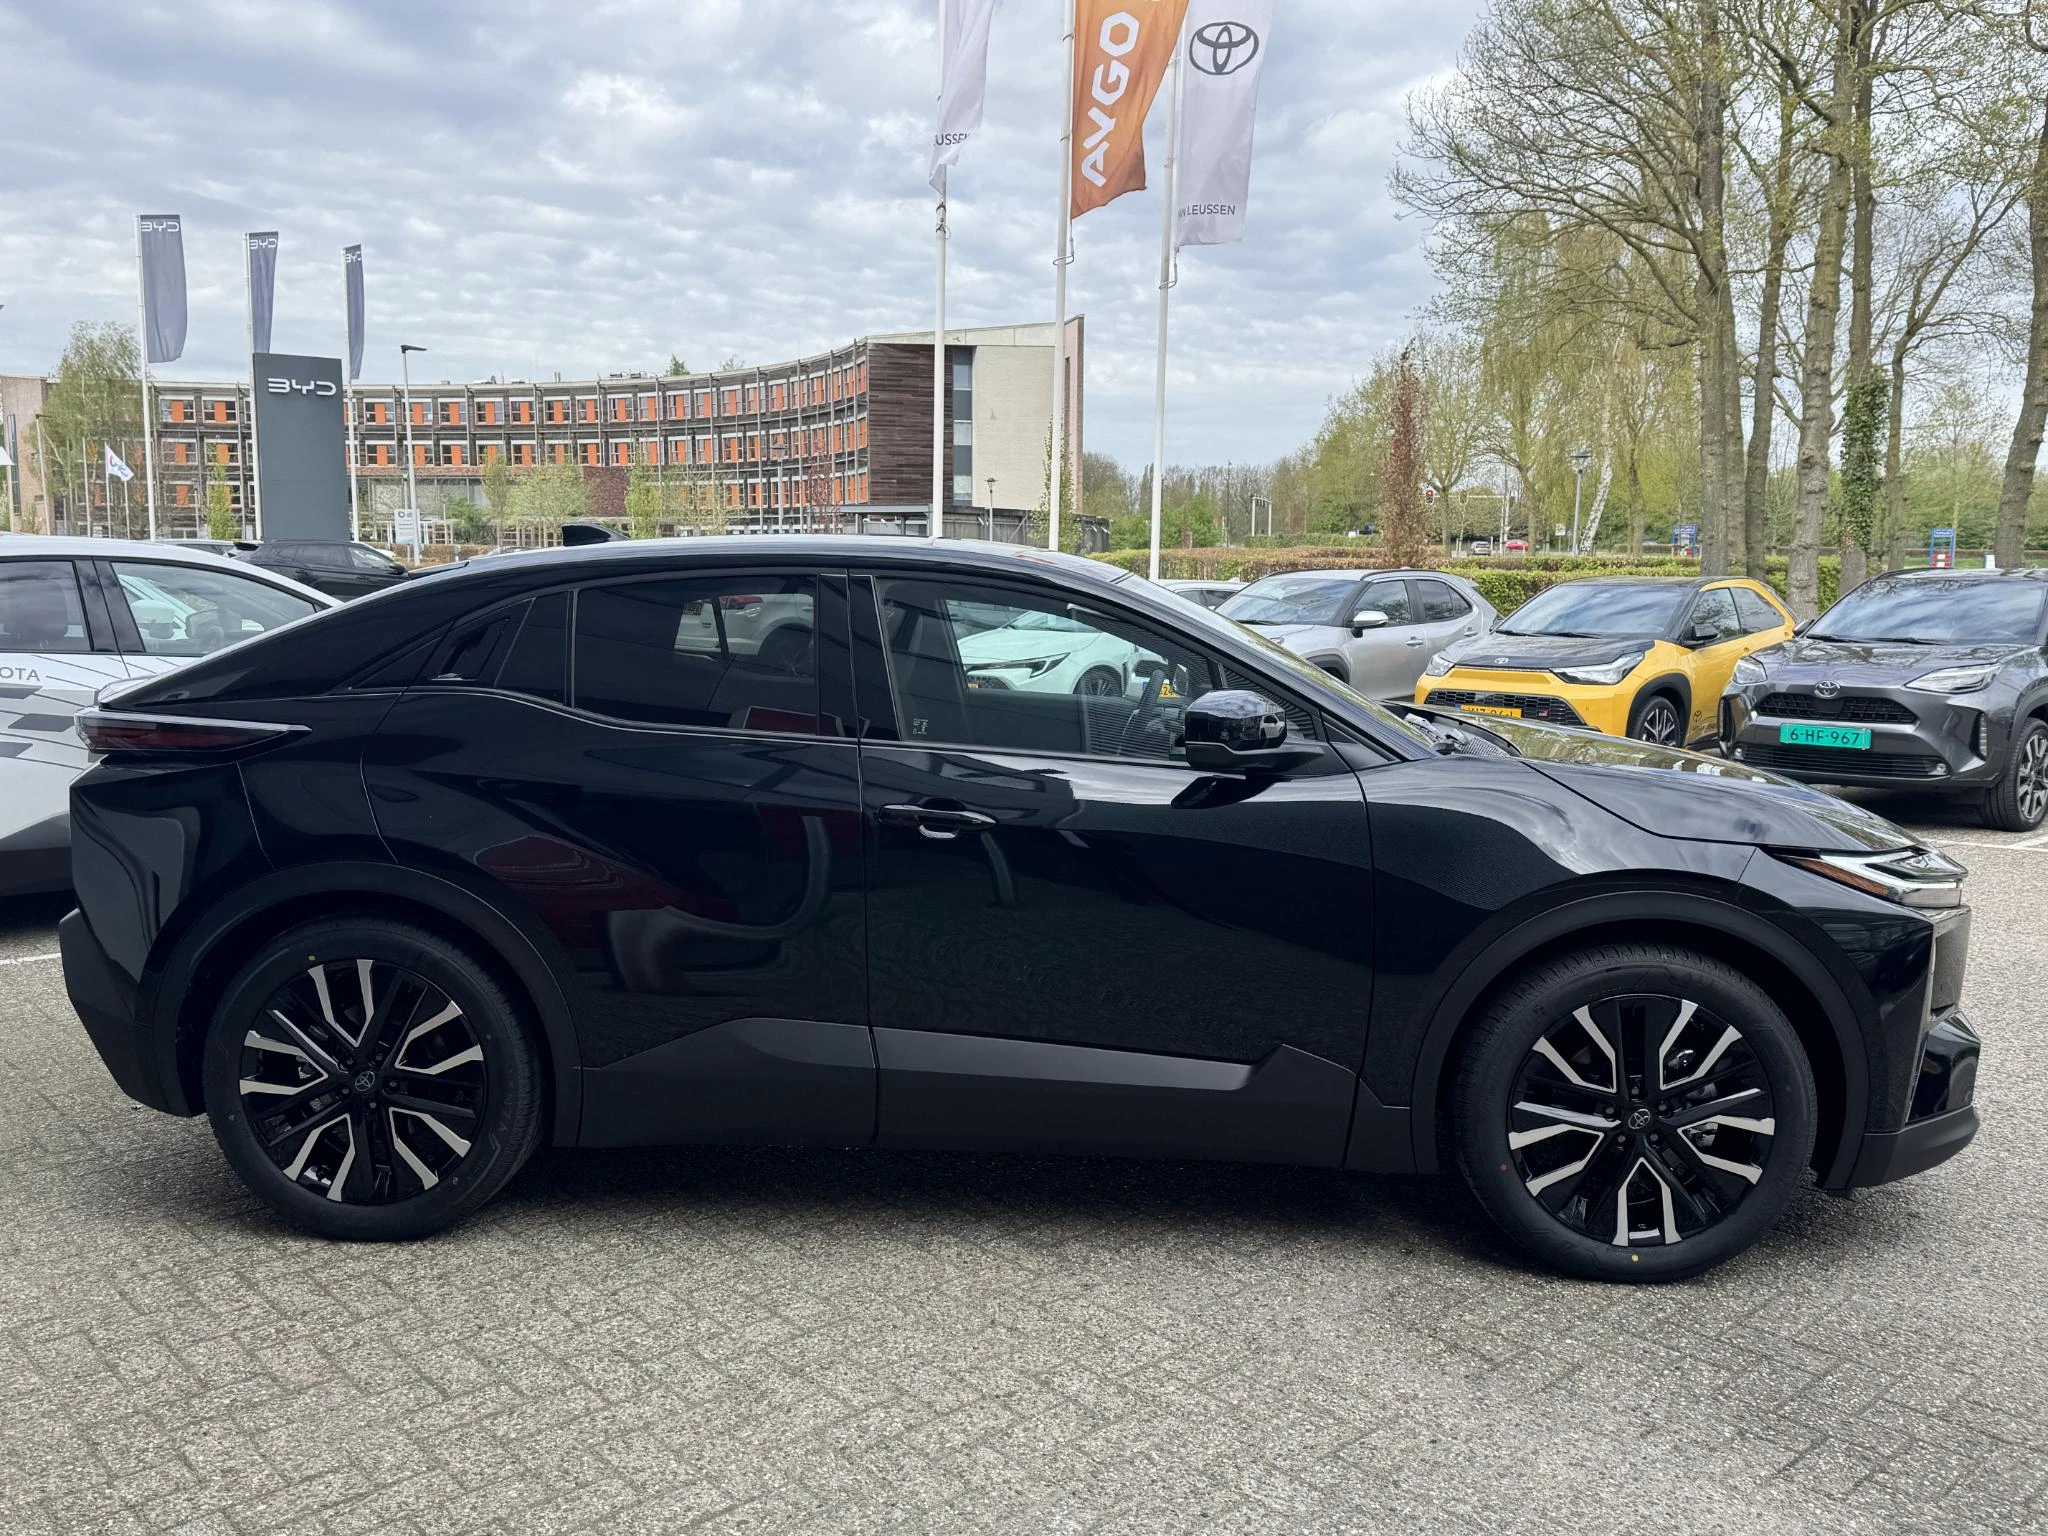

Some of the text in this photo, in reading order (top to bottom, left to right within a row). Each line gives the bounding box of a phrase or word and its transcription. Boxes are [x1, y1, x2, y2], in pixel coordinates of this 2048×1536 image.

[1081, 11, 1140, 188] AYGO
[1187, 204, 1236, 216] LEUSSEN
[140, 221, 179, 232] BYD
[249, 238, 277, 249] BYD
[267, 377, 337, 396] BYD
[1790, 728, 1860, 745] 6-HF-967
